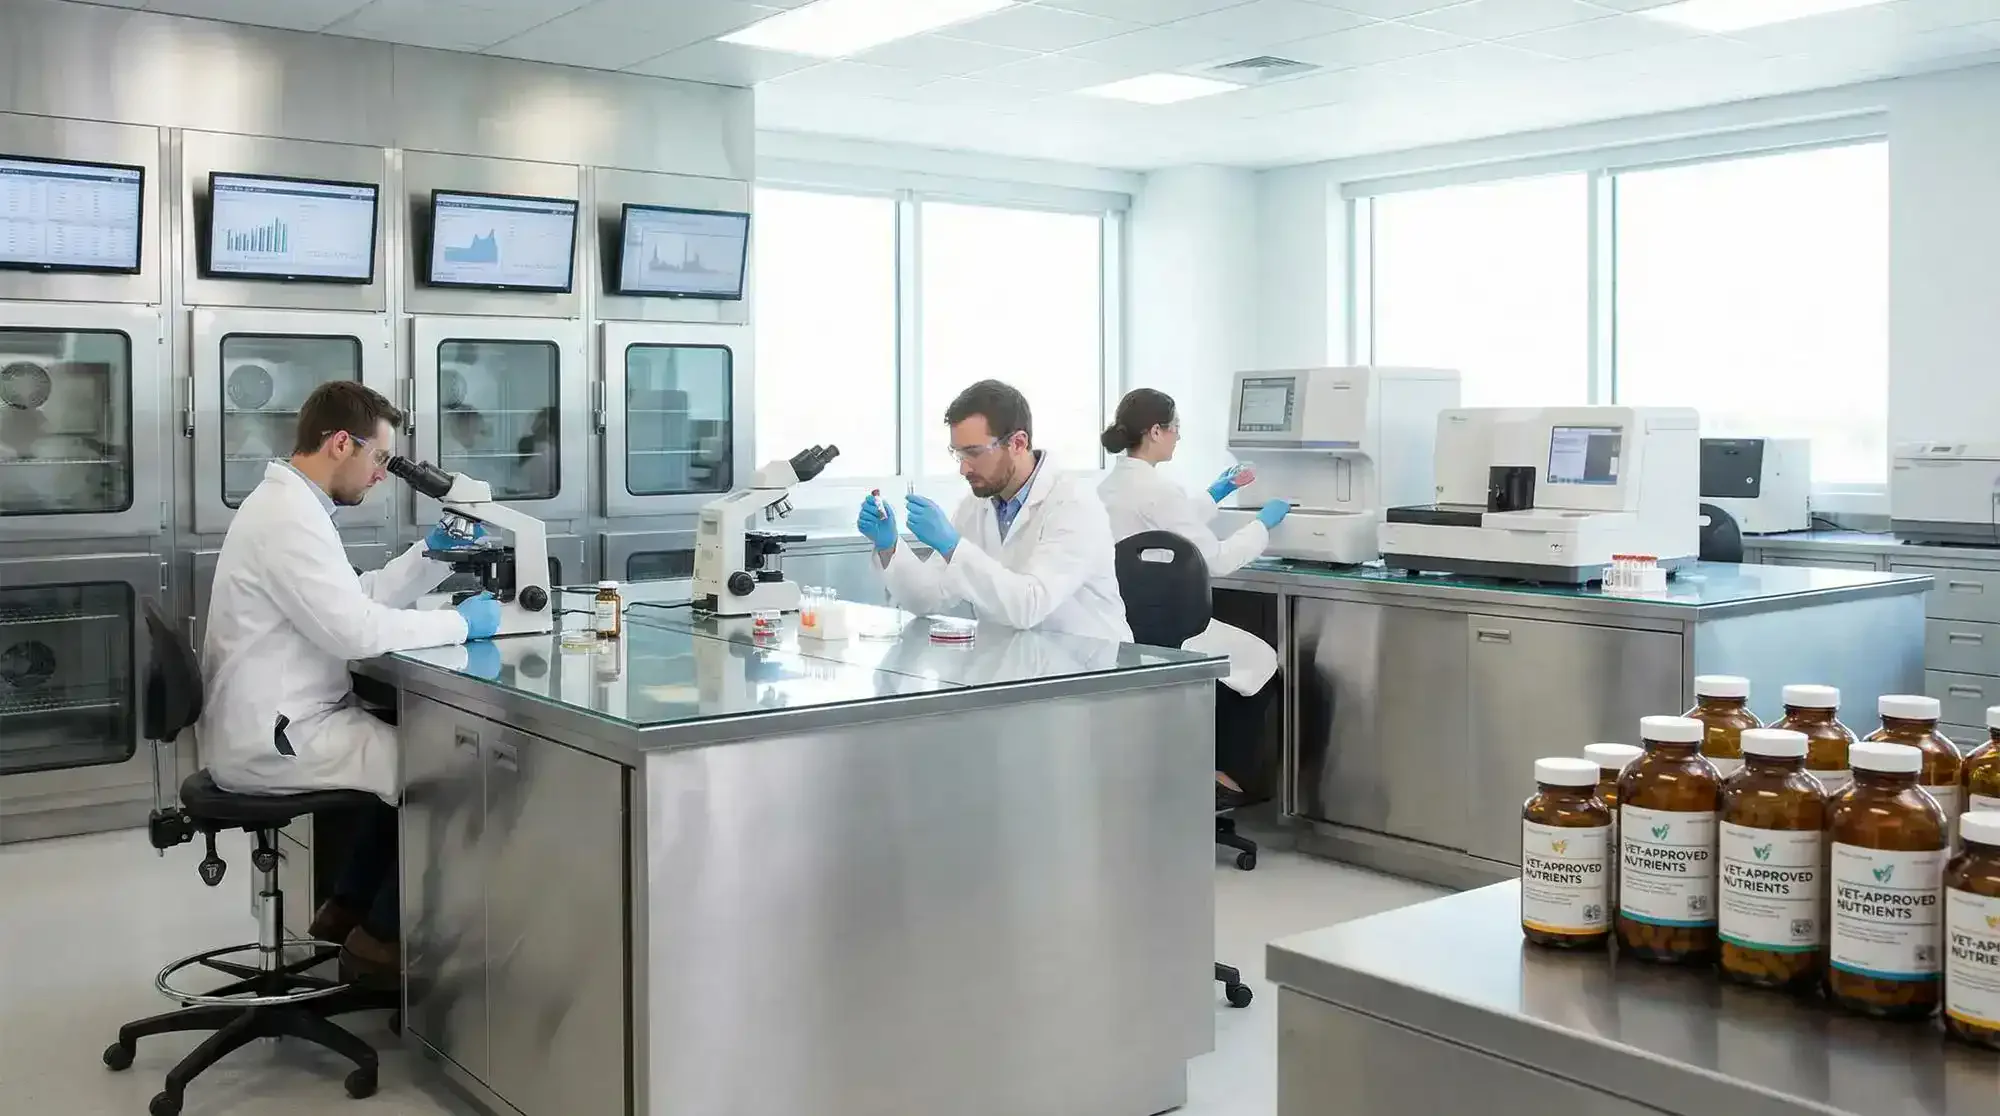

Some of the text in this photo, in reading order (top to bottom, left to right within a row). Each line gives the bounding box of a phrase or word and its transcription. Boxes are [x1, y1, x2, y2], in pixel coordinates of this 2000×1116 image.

[1624, 843, 1709, 861] VET-APPROVED
[1624, 855, 1687, 873] NUTRIENTS
[1724, 863, 1814, 882] VET-APPROVED
[1724, 875, 1790, 895] NUTRIENTS
[1837, 885, 1936, 907] VET-APPROVED
[1837, 898, 1912, 919] NUTRIENTS
[1952, 931, 2000, 953] VET-AP
